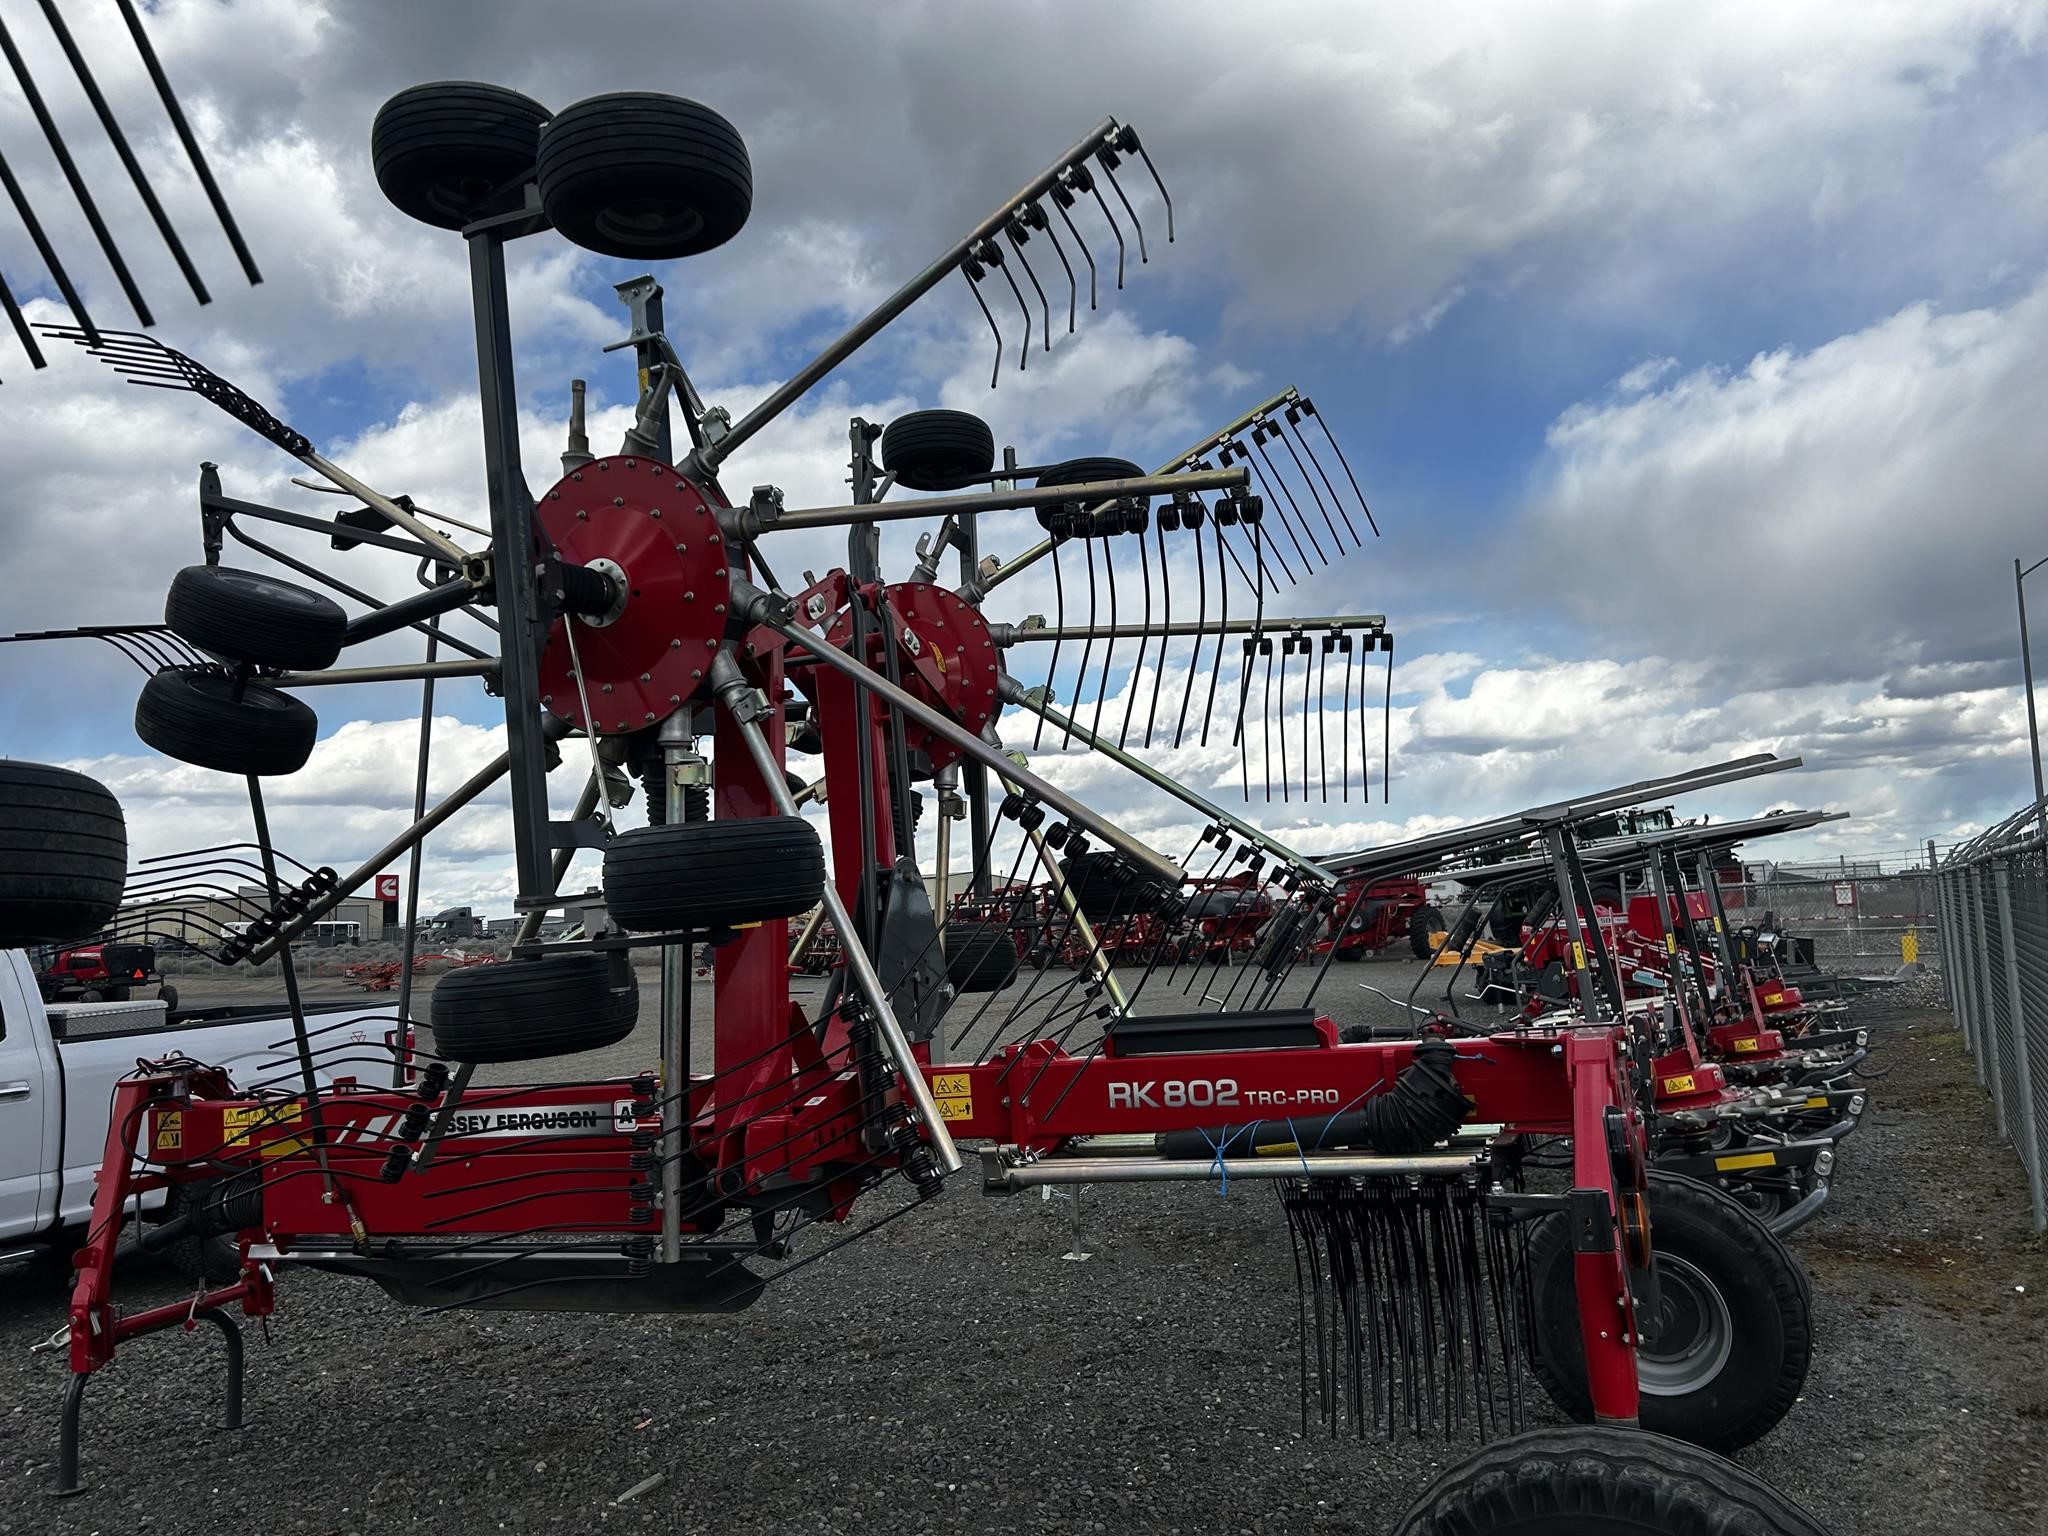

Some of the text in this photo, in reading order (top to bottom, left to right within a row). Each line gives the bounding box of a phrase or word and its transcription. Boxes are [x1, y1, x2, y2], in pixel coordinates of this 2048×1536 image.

[1107, 1079, 1339, 1108] RK 802 TRC-PRO
[447, 1111, 598, 1132] SSEY FERGUSON
